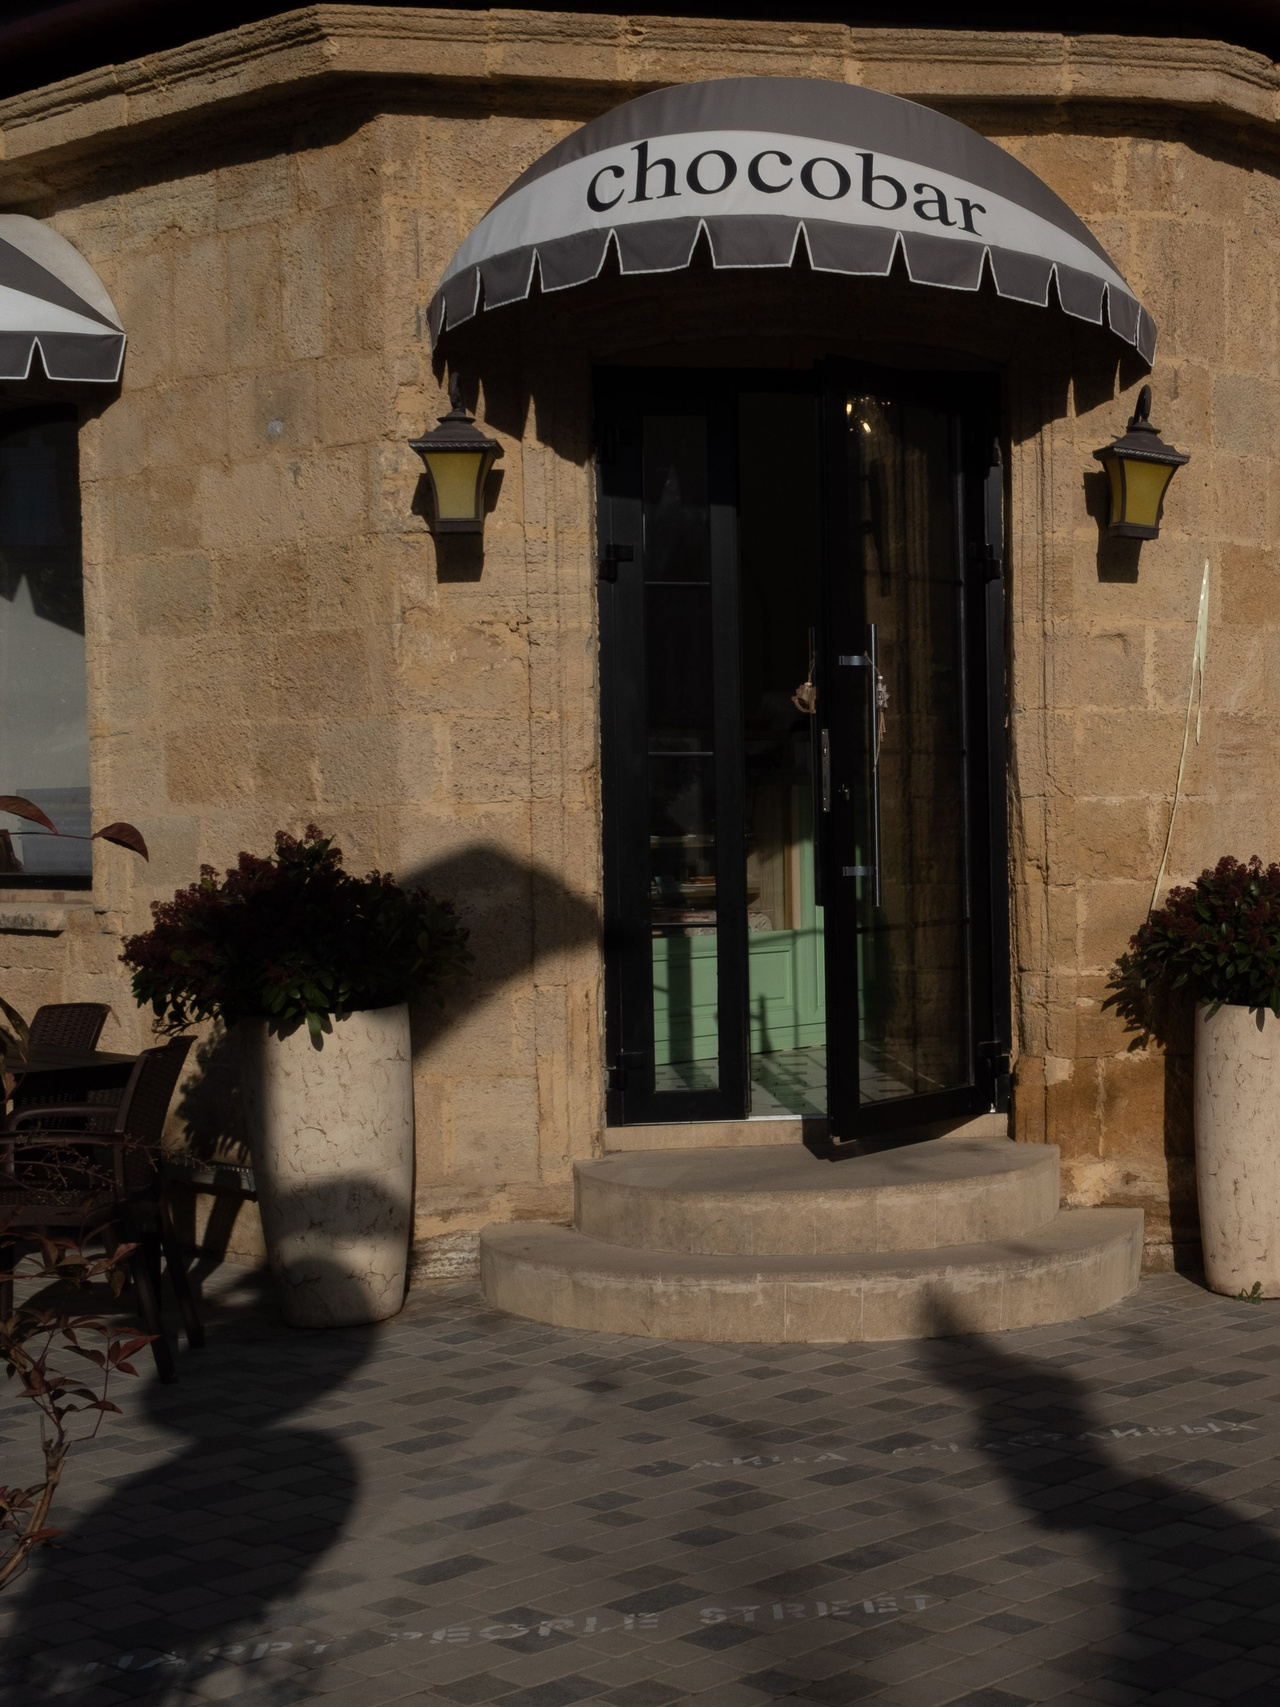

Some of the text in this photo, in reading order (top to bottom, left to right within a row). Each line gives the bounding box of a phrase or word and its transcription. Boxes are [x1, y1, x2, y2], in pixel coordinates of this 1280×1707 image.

[586, 140, 987, 237] chocobar
[385, 1612, 660, 1645] PEOPLE
[699, 1593, 933, 1627] STREET
